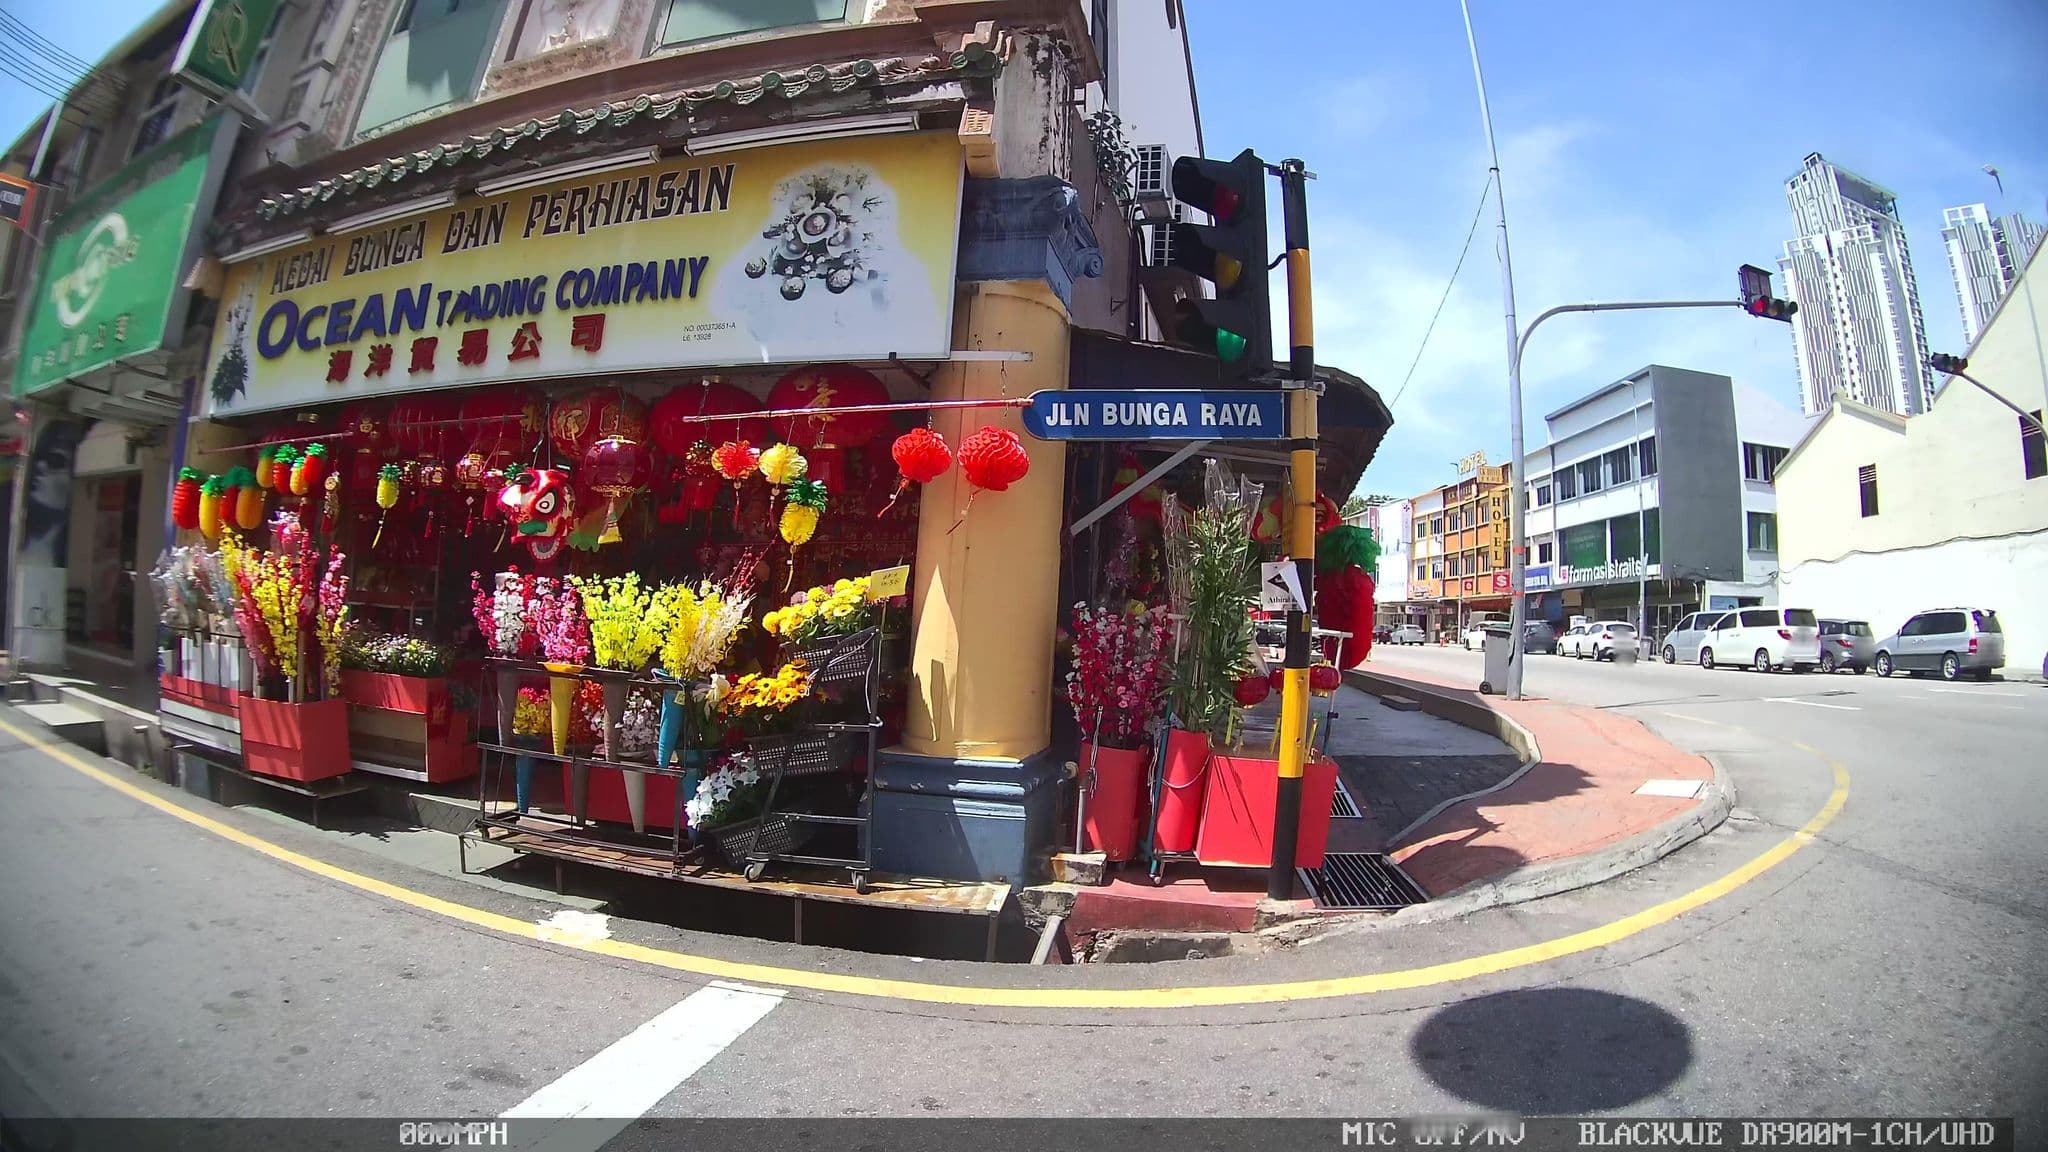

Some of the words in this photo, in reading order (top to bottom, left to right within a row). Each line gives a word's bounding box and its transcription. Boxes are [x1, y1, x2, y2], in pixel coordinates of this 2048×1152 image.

[270, 244, 336, 295] KEDAI
[343, 221, 427, 277] BUNGA
[442, 201, 510, 254] DAN
[522, 163, 735, 240] PERHIASAN
[257, 282, 433, 359] OCEAN
[555, 256, 709, 311] COMPANY
[1046, 403, 1090, 426] JLN
[1102, 403, 1188, 426] BUNGA
[1201, 403, 1262, 427] RAYA
[1492, 497, 1502, 561] HOTEL
[1568, 560, 1607, 584] farmasi
